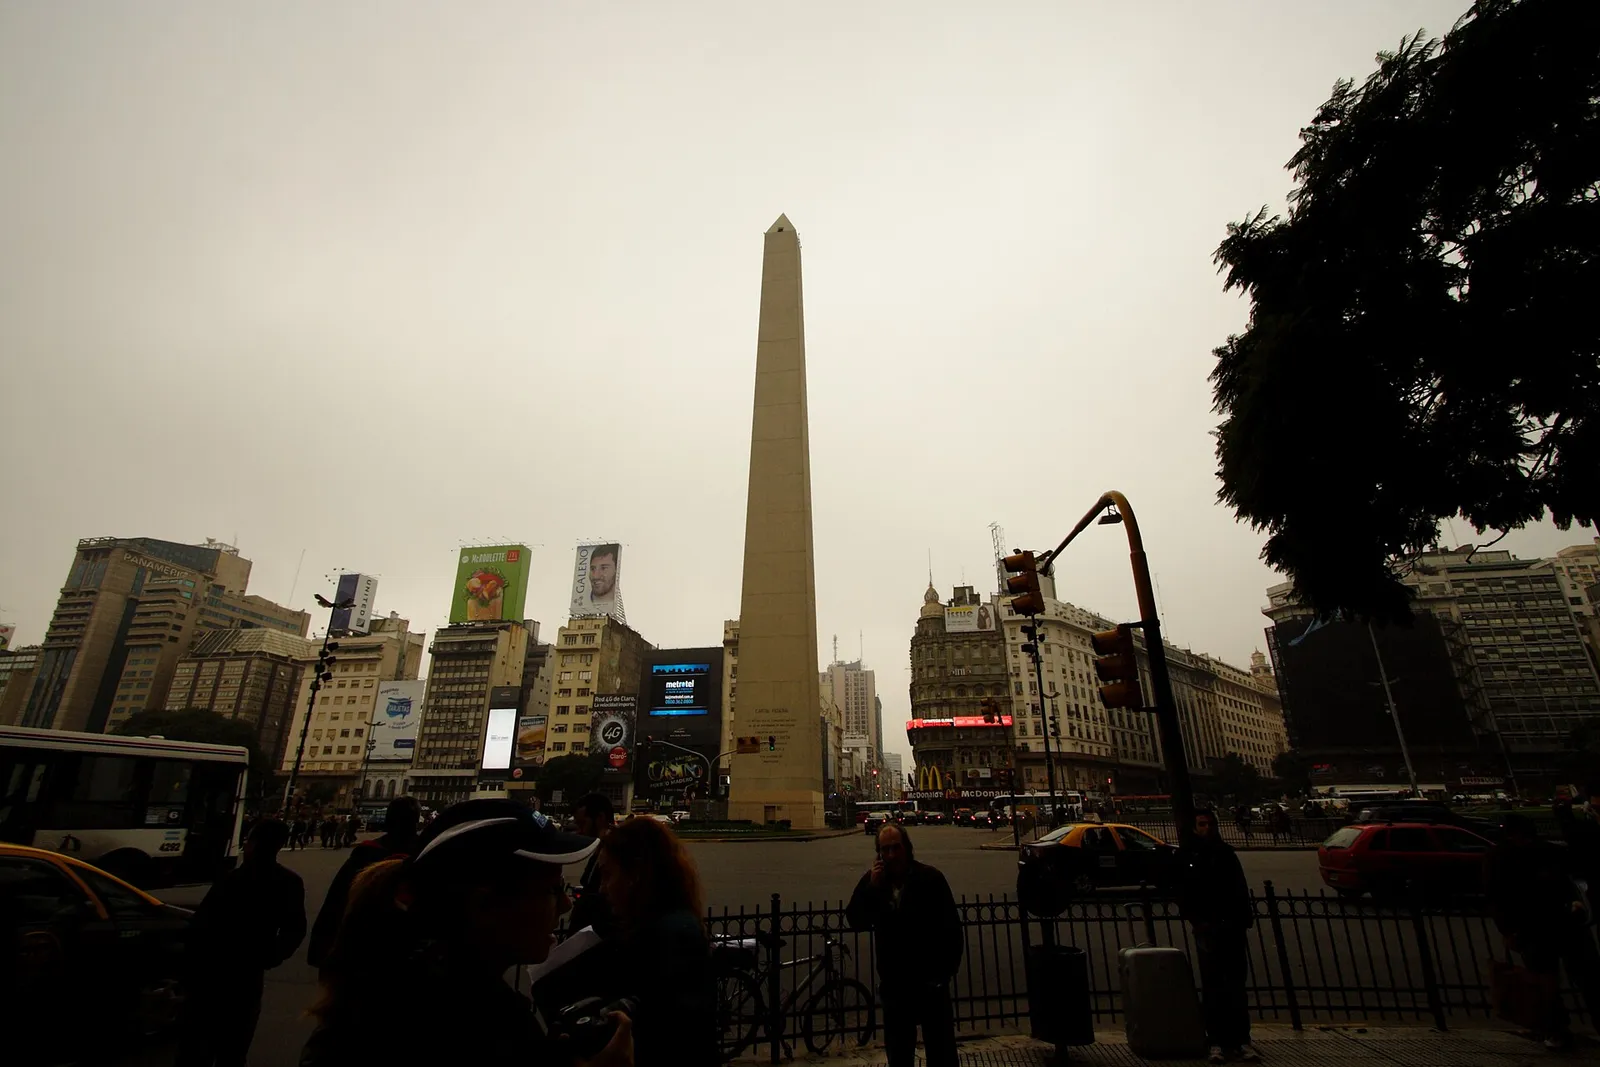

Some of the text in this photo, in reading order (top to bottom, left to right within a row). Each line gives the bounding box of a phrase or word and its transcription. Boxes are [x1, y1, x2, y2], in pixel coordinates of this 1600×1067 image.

[576, 549, 588, 593] GALENO
[360, 579, 371, 616] UNITED
[604, 726, 621, 740] 4G
